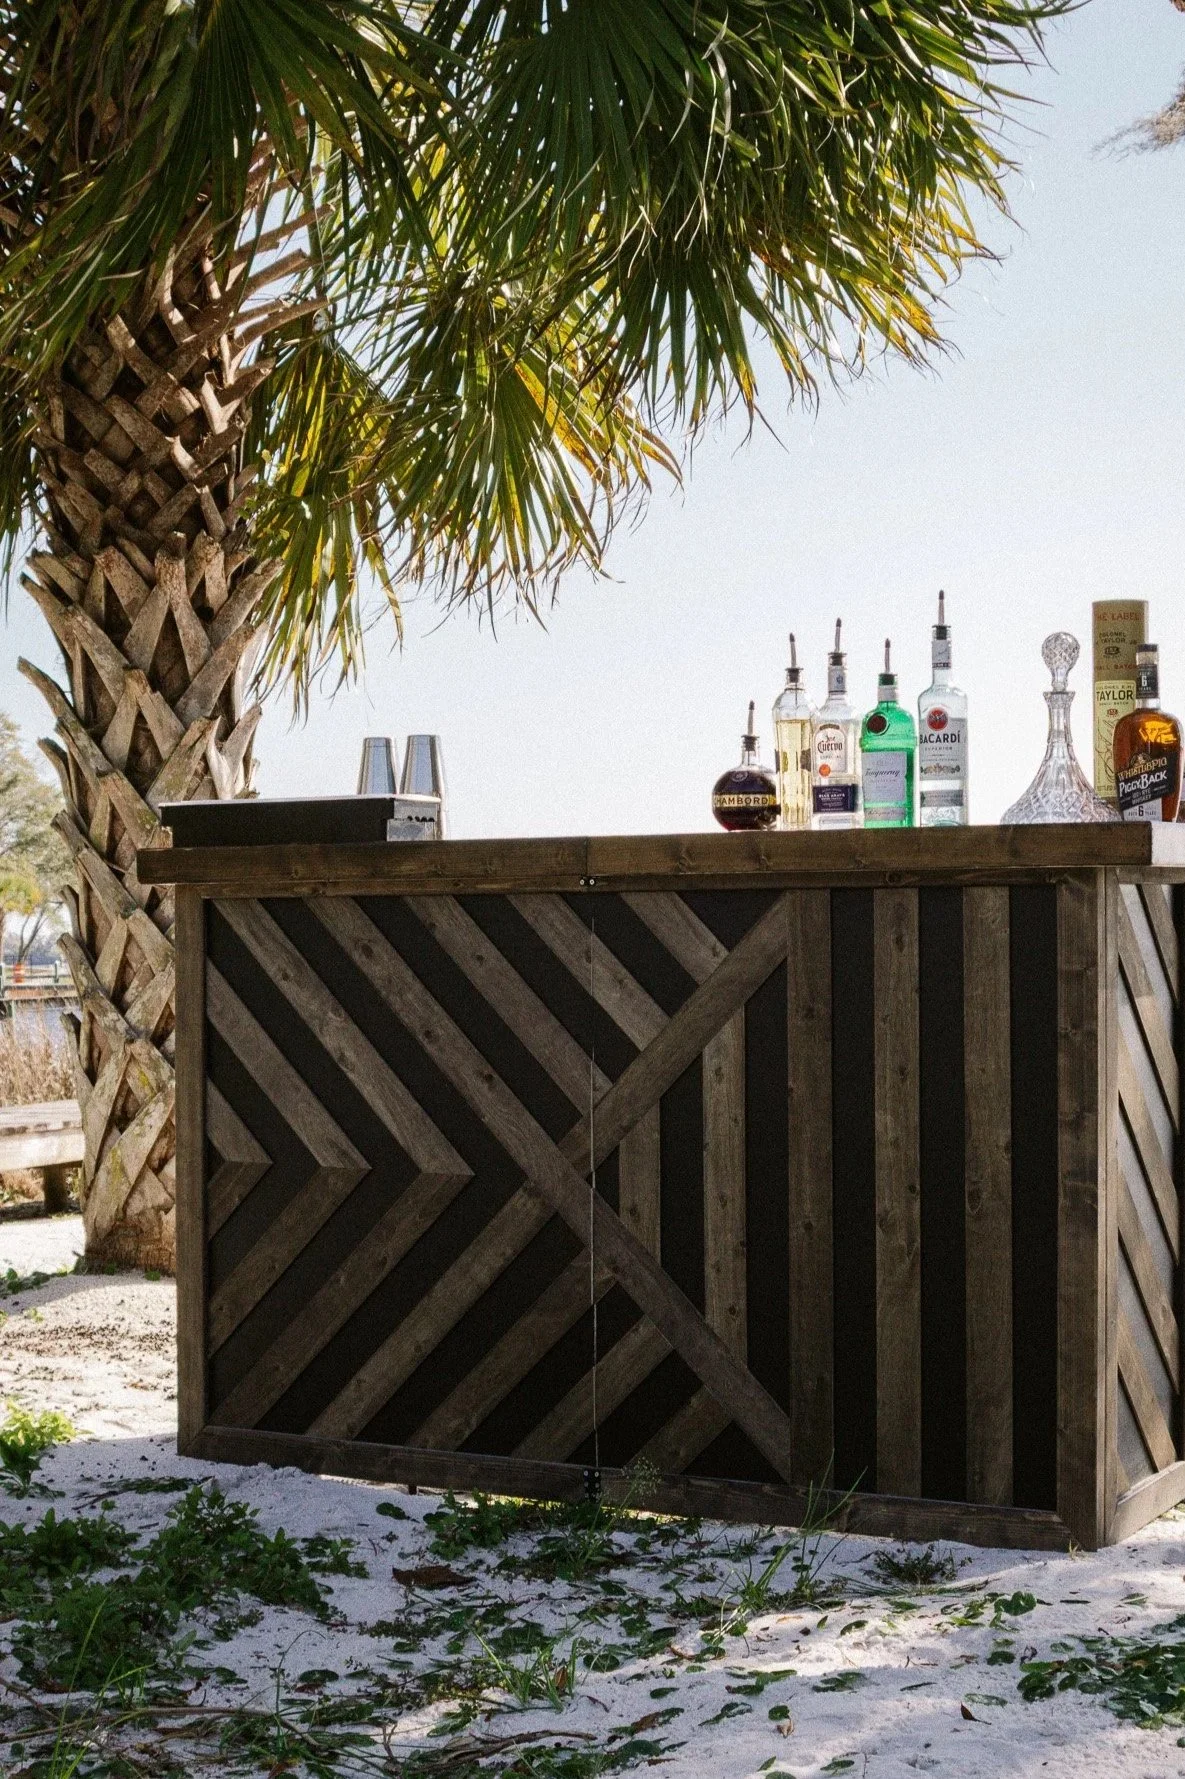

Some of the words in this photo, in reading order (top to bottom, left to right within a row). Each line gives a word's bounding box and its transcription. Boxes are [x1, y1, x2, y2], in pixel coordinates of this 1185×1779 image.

[1141, 675, 1148, 687] 6
[1096, 689, 1134, 701] TAYLOR
[919, 730, 961, 744] BACARDÍ
[714, 796, 768, 805] HAMBORD
[1138, 805, 1144, 817] 6
